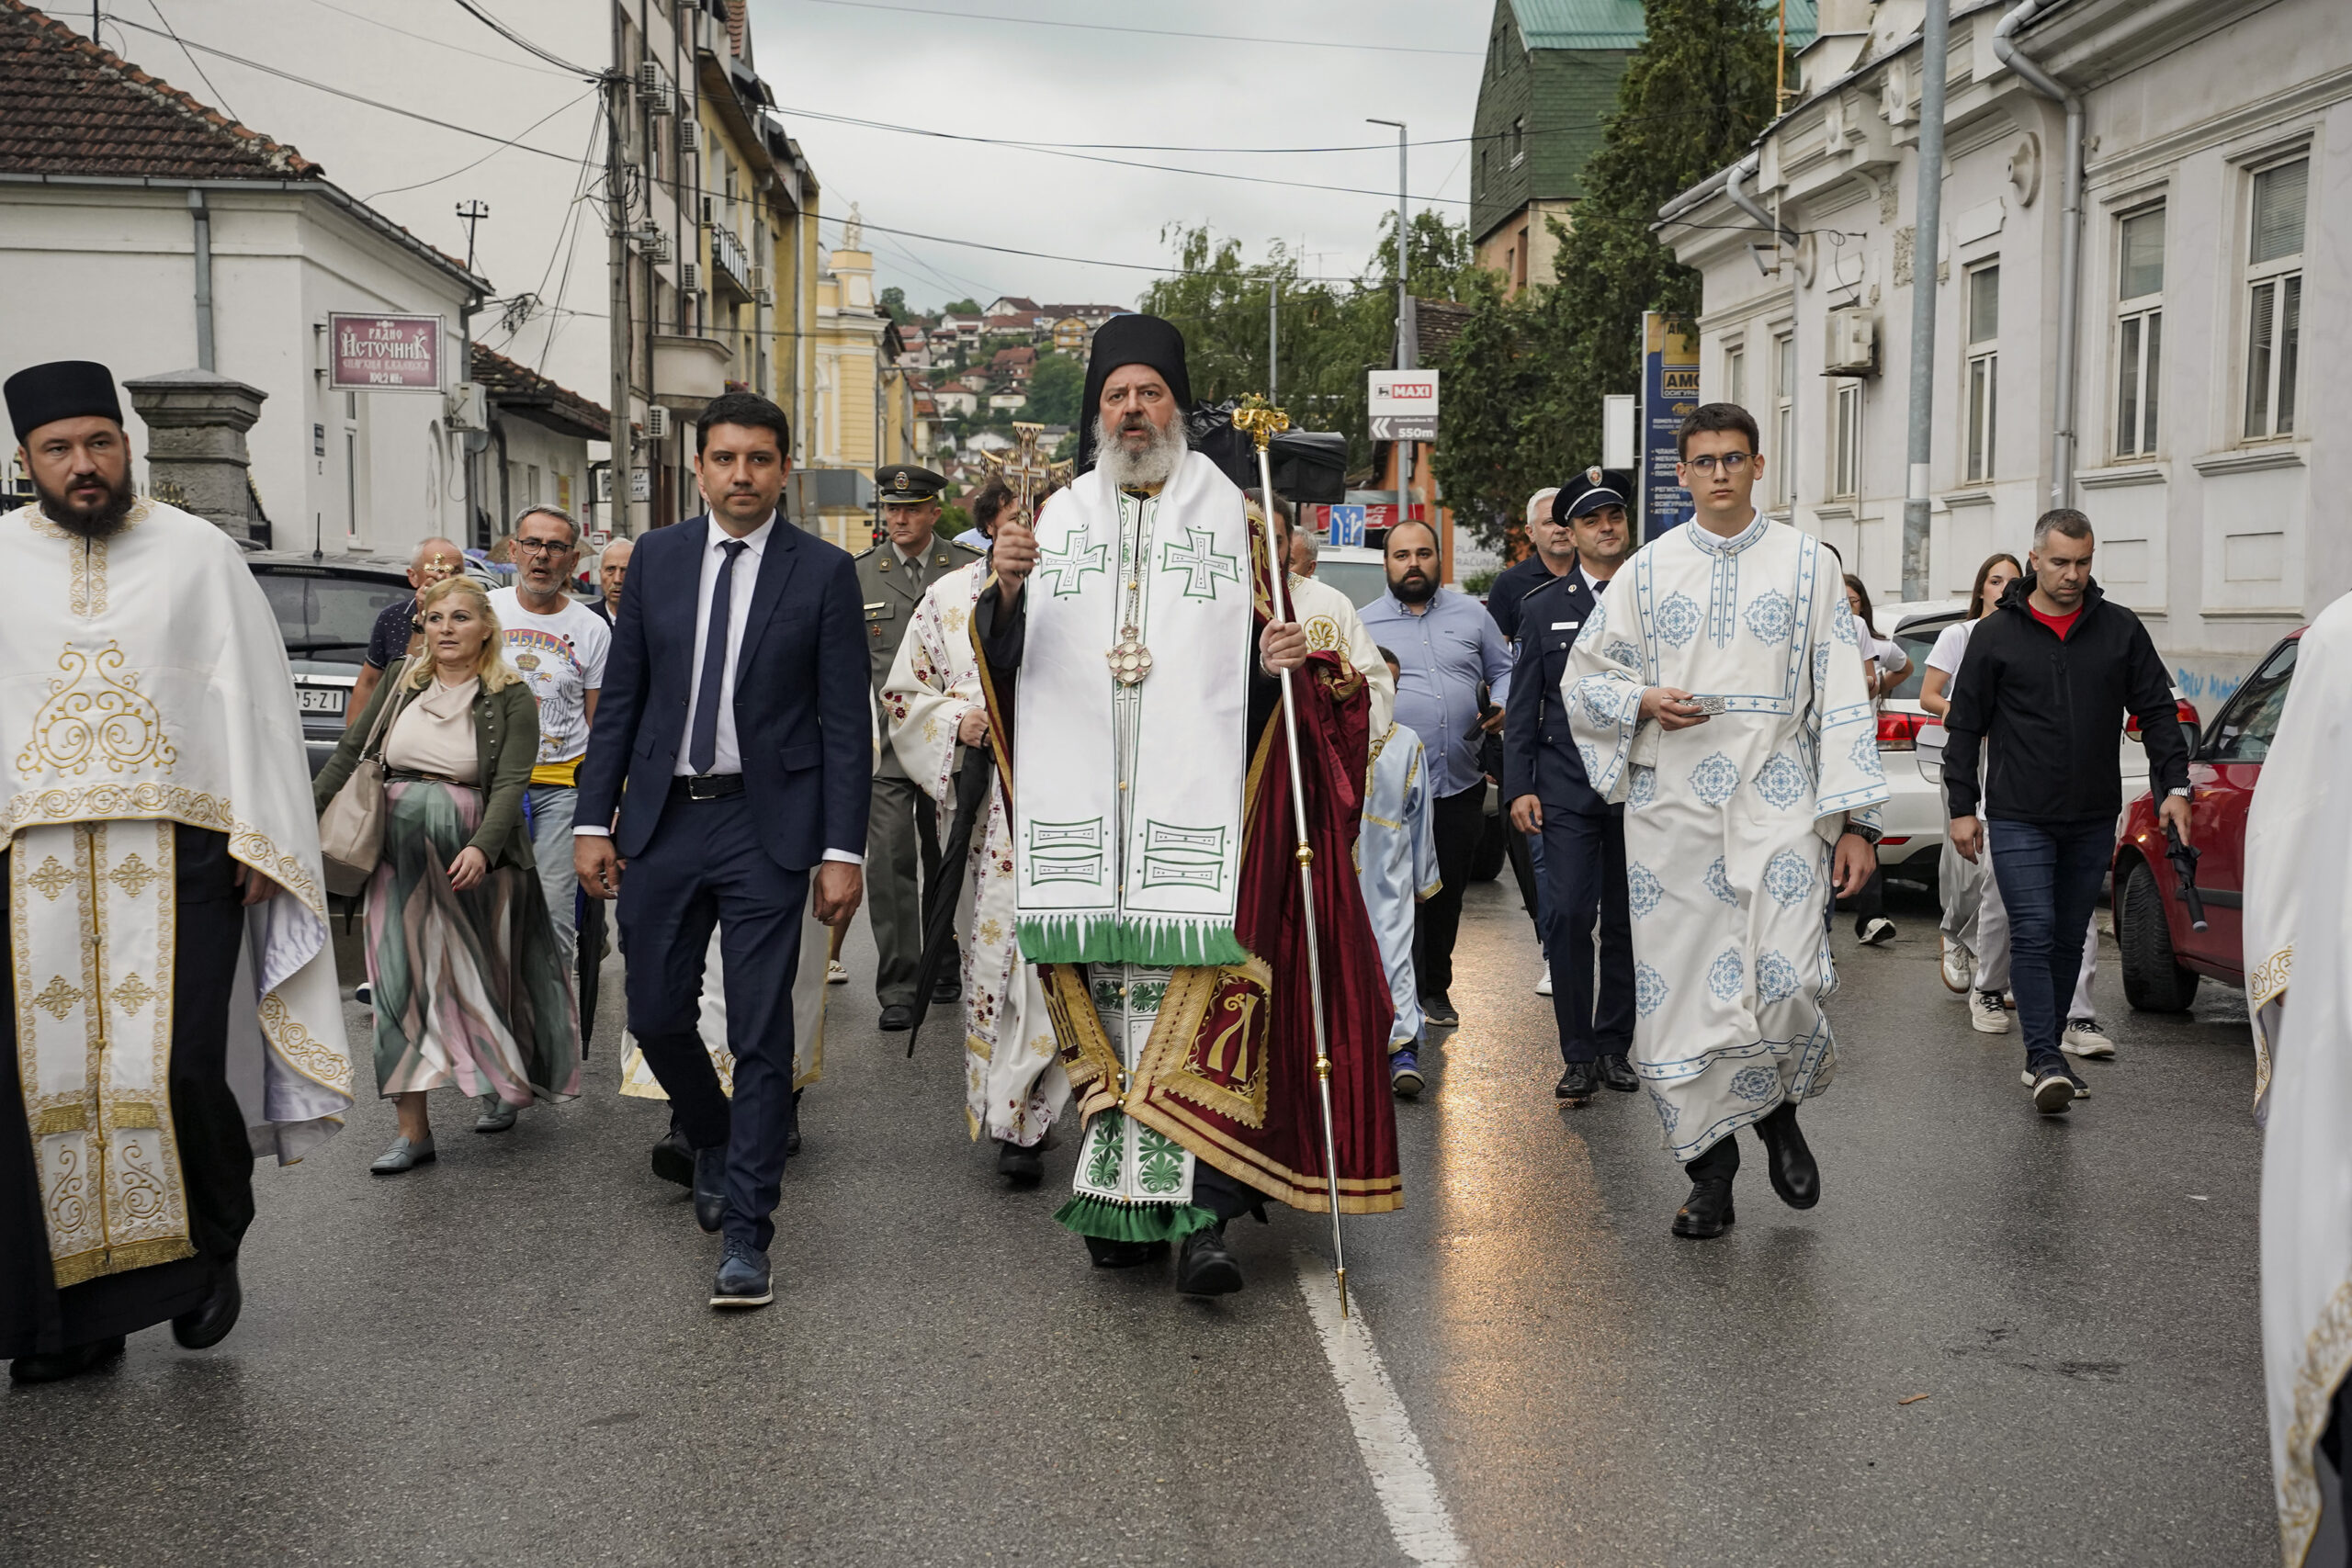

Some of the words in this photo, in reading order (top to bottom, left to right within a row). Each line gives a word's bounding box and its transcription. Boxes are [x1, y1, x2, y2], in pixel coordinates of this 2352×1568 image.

[1394, 386, 1430, 397] MAXI
[1398, 427, 1434, 438] 550m
[503, 629, 571, 660] РБИЈА
